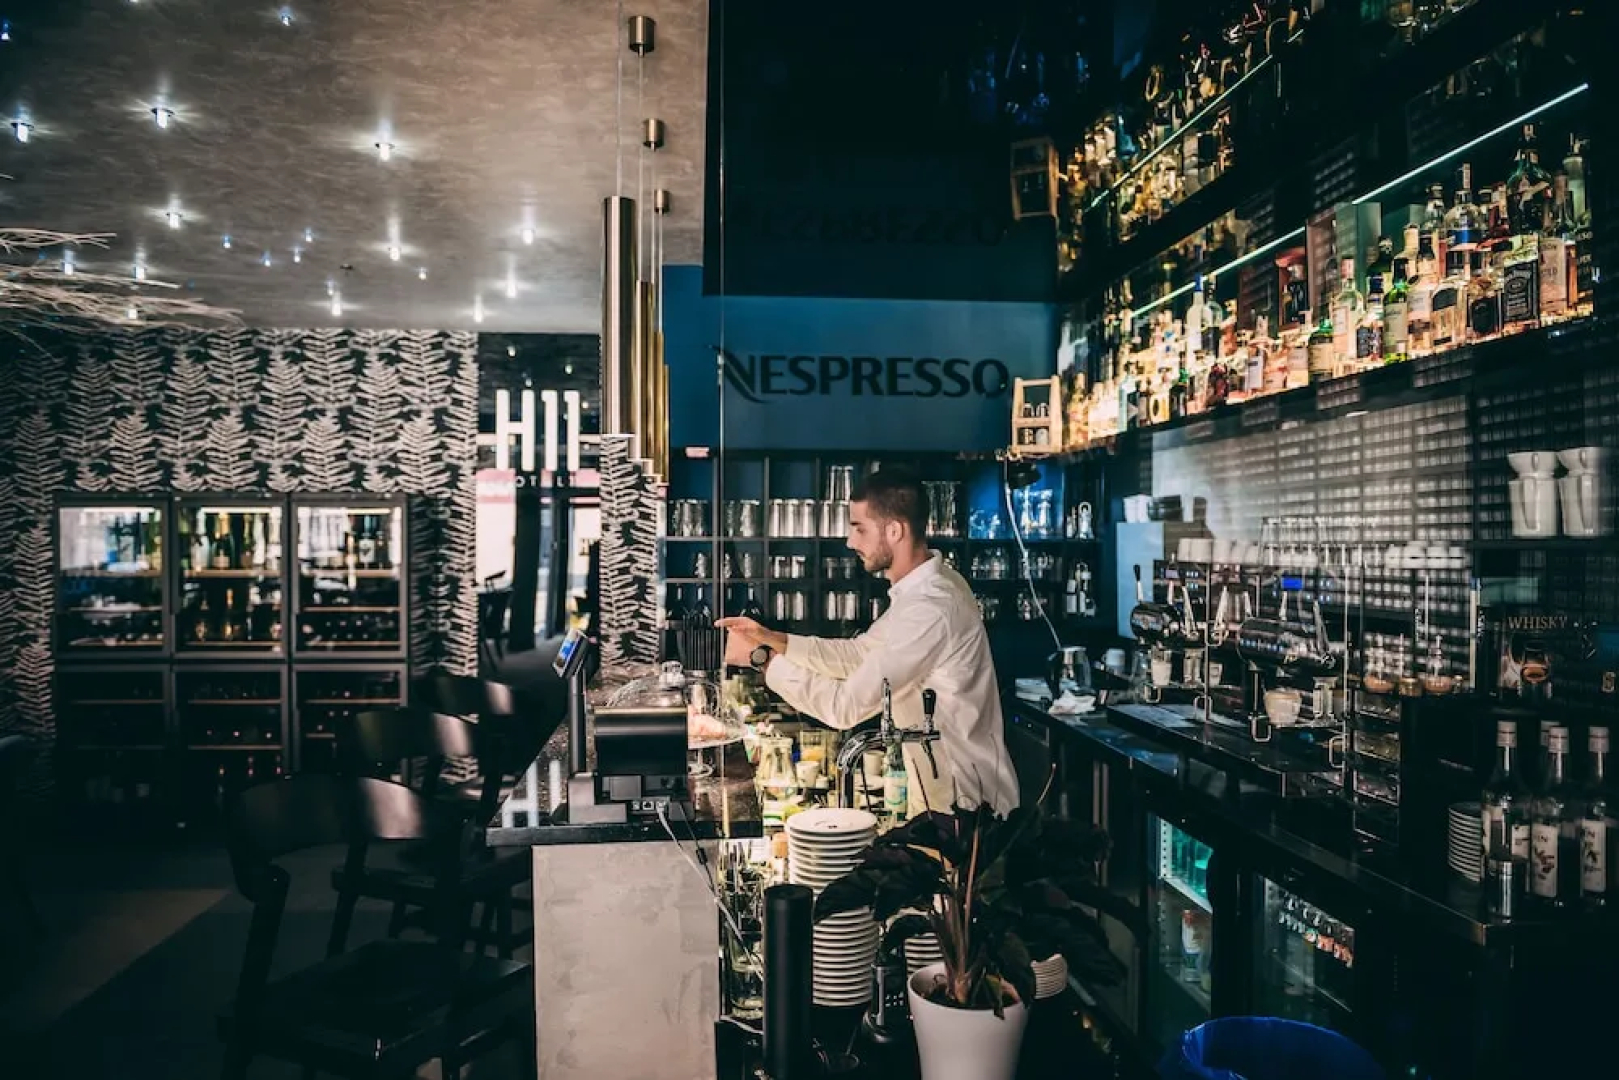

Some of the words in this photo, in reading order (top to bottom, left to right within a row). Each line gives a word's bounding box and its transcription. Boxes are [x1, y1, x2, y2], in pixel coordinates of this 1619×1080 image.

[710, 344, 1009, 403] NESPRESSO
[496, 389, 580, 471] H11
[1508, 616, 1567, 629] WHISKY
